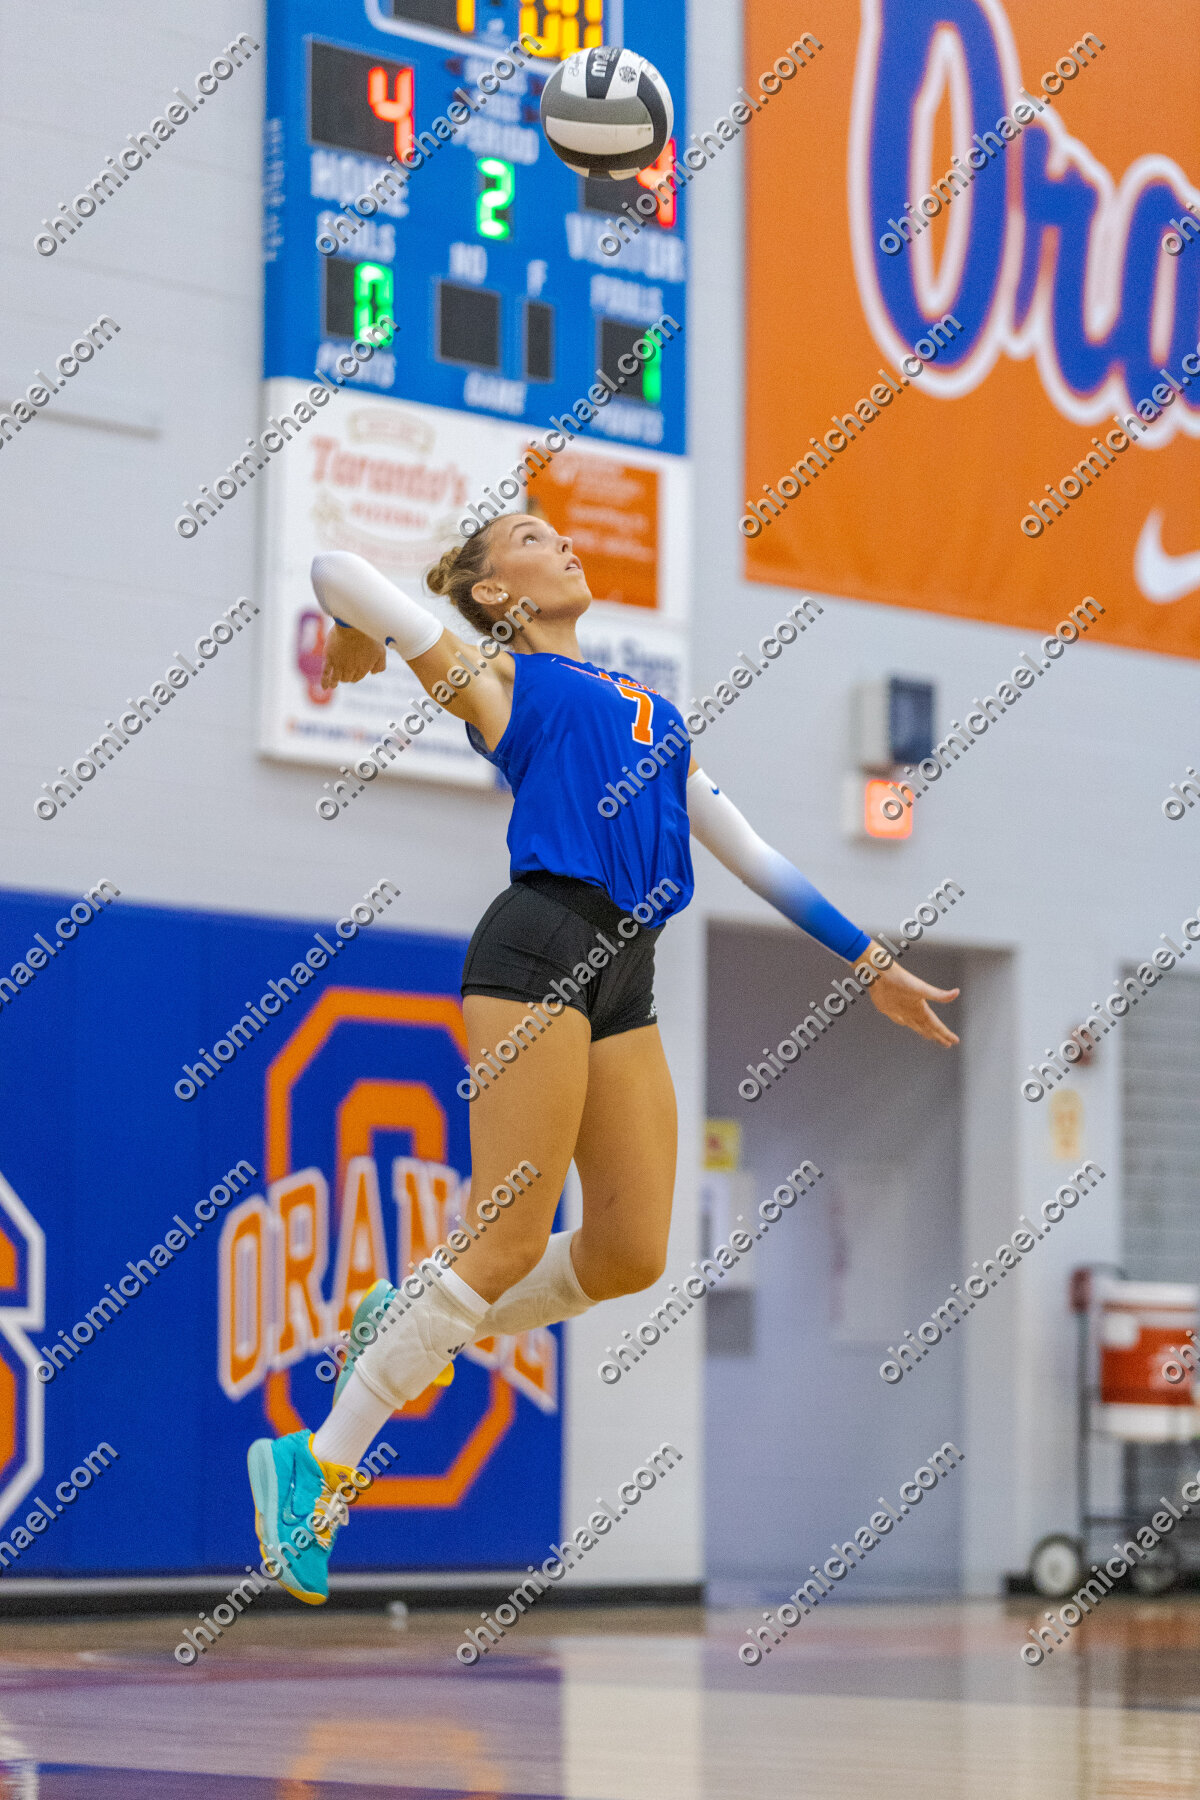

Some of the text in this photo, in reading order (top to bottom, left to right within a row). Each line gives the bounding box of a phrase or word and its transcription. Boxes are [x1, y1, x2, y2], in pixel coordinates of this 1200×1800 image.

[367, 65, 414, 165] 4
[476, 157, 515, 240] 2
[353, 261, 395, 347] 0
[614, 683, 654, 746] 7
